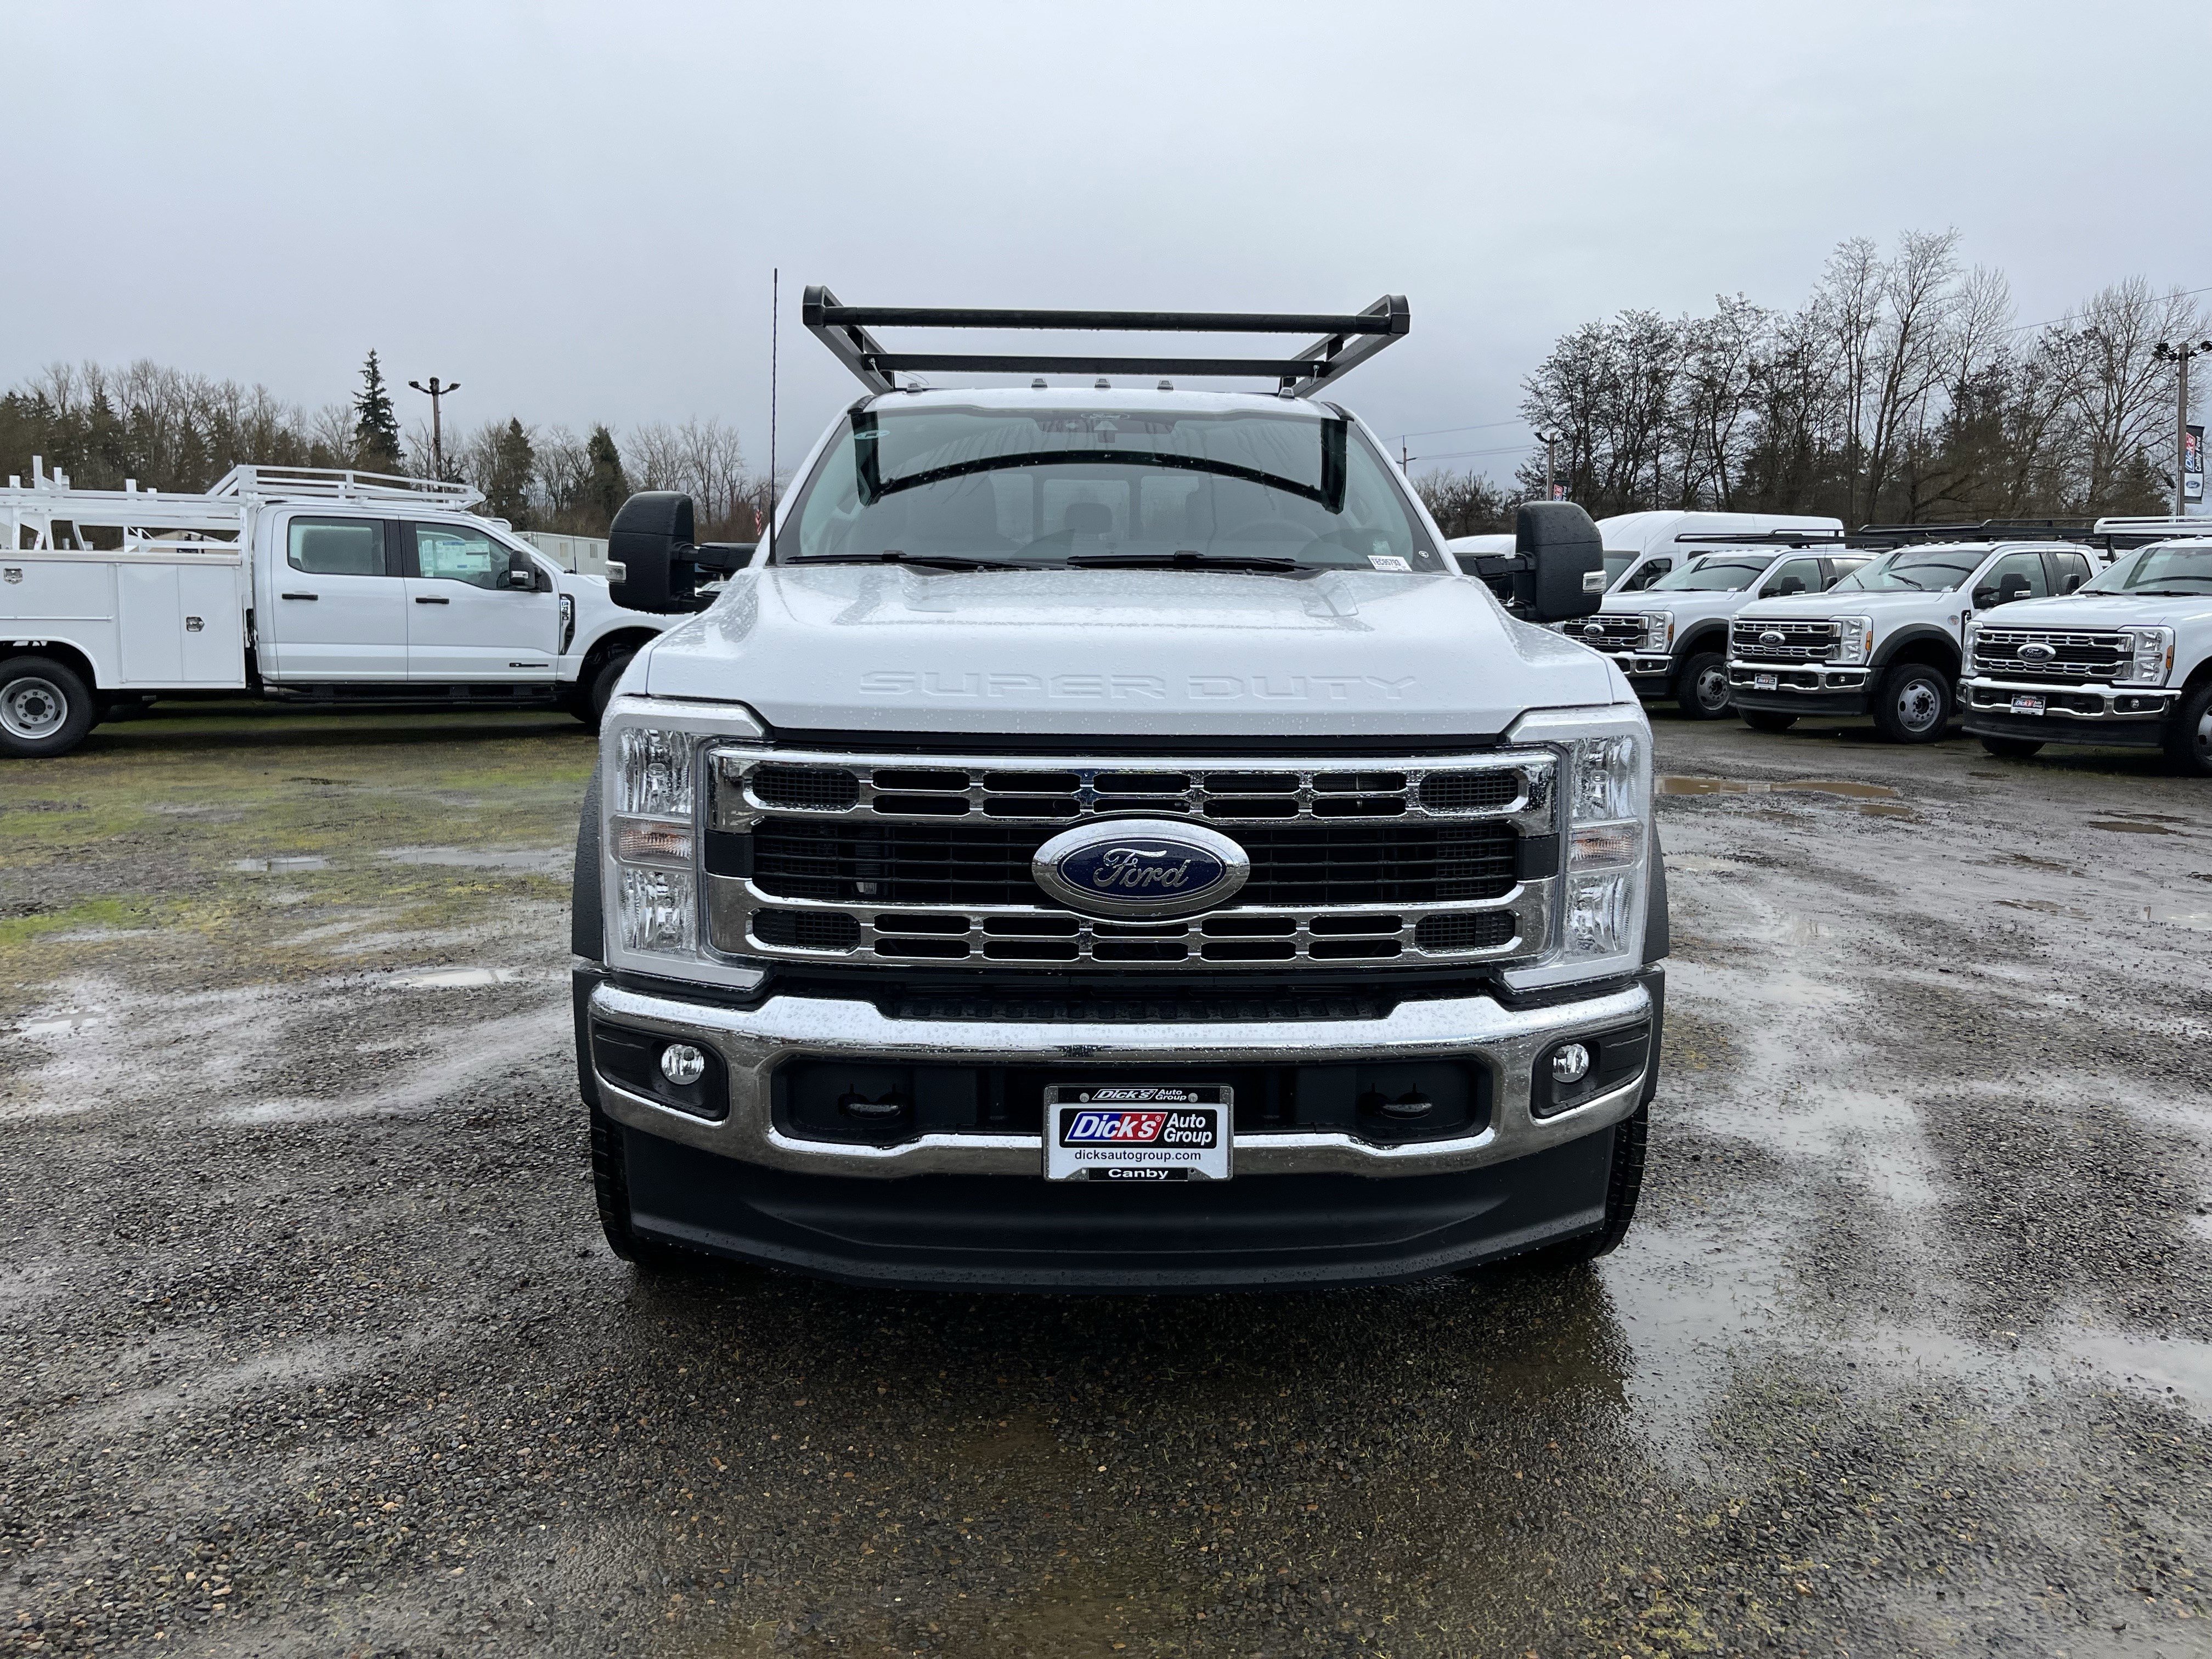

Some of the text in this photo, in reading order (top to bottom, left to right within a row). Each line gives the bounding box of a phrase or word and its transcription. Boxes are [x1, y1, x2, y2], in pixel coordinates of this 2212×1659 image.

[2025, 648, 2044, 658] Ford
[859, 671, 1417, 700] SUPER DUTY
[1093, 847, 1192, 888] Ford
[1097, 1090, 1151, 1099] Dick's
[1073, 1115, 1156, 1138] Dick's
[1166, 1113, 1206, 1128] Auto
[1163, 1127, 1212, 1146] Group
[1074, 1149, 1201, 1162] dicksautogroup.com
[1108, 1169, 1169, 1180] Canby
